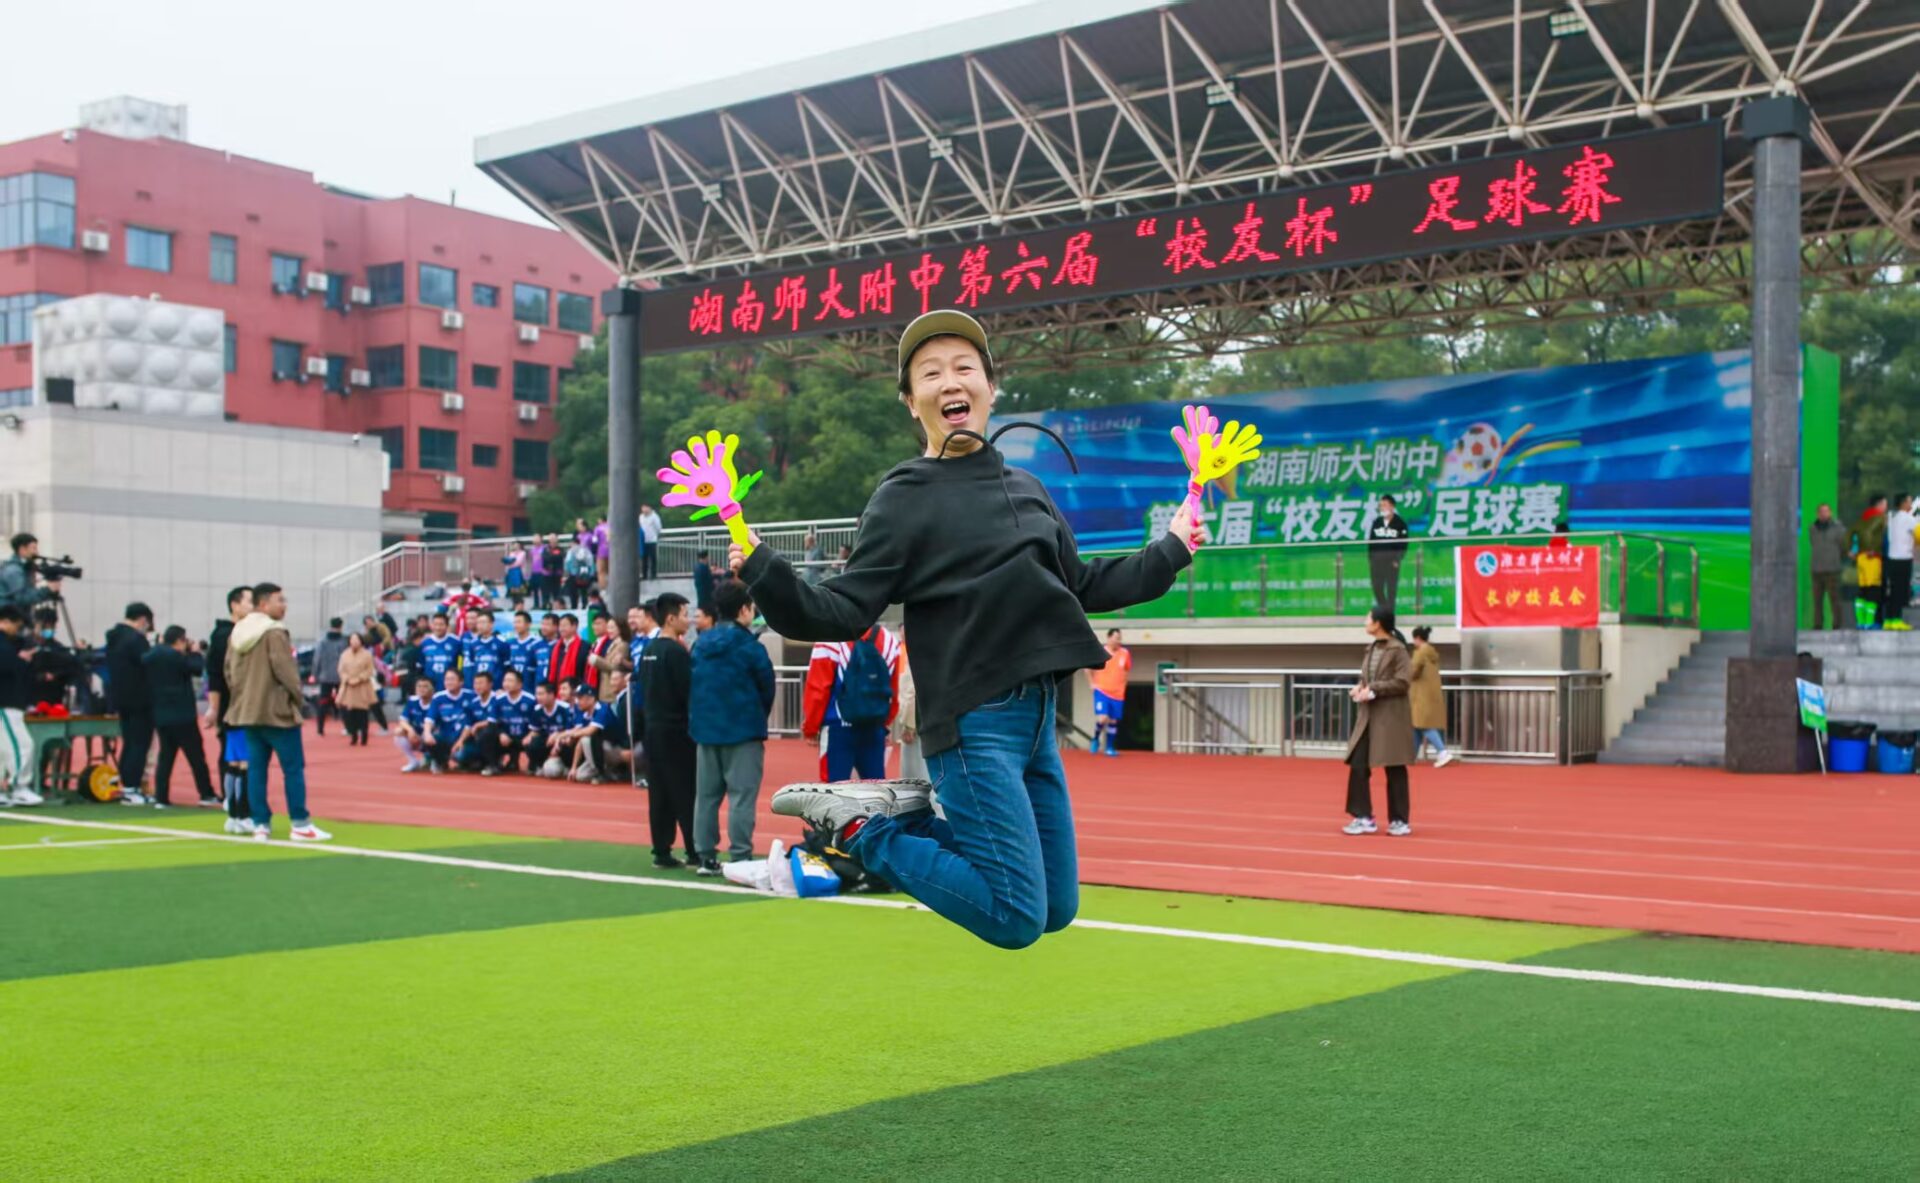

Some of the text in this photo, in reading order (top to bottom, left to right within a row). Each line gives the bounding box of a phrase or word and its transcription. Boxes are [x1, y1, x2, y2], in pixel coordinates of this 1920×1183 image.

[689, 146, 1622, 335] 湖南师大附中第六届“校友杯”足球赛
[1246, 440, 1439, 487] 湖南师大附中
